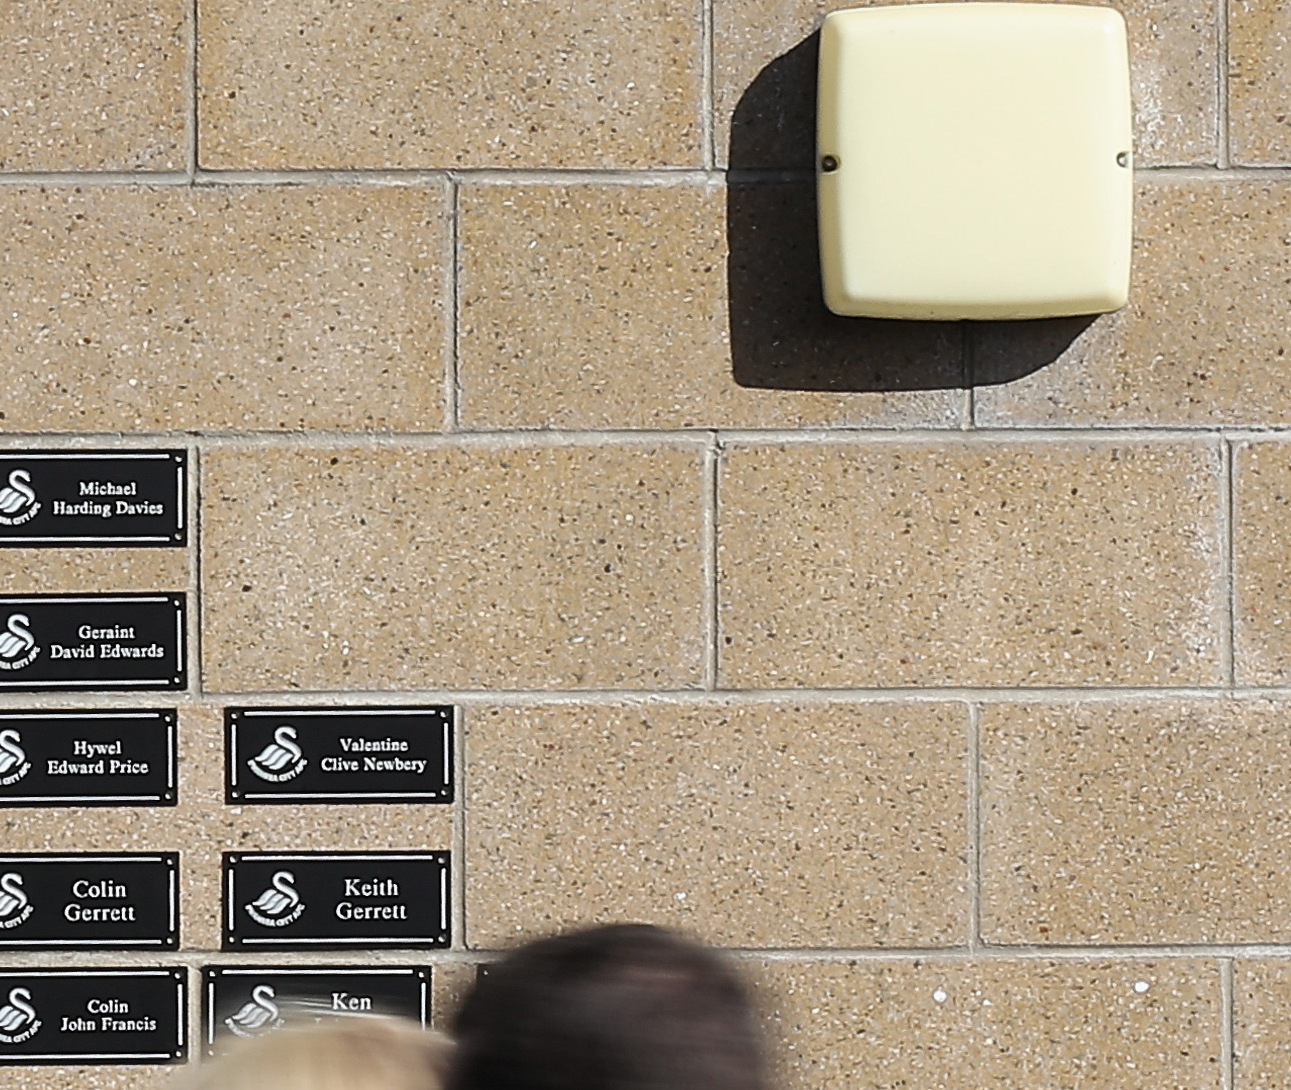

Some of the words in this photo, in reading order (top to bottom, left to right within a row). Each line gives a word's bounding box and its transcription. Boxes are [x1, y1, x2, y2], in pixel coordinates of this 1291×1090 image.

[79, 481, 137, 496] Michael
[78, 624, 136, 640] Geraint
[73, 740, 122, 759] Hywel
[72, 879, 127, 899] Colin
[344, 878, 399, 897] Keith
[64, 903, 136, 922] Gerrett
[335, 901, 407, 920] Gerrett
[87, 999, 129, 1014] Colin
[331, 992, 373, 1011] Ken
